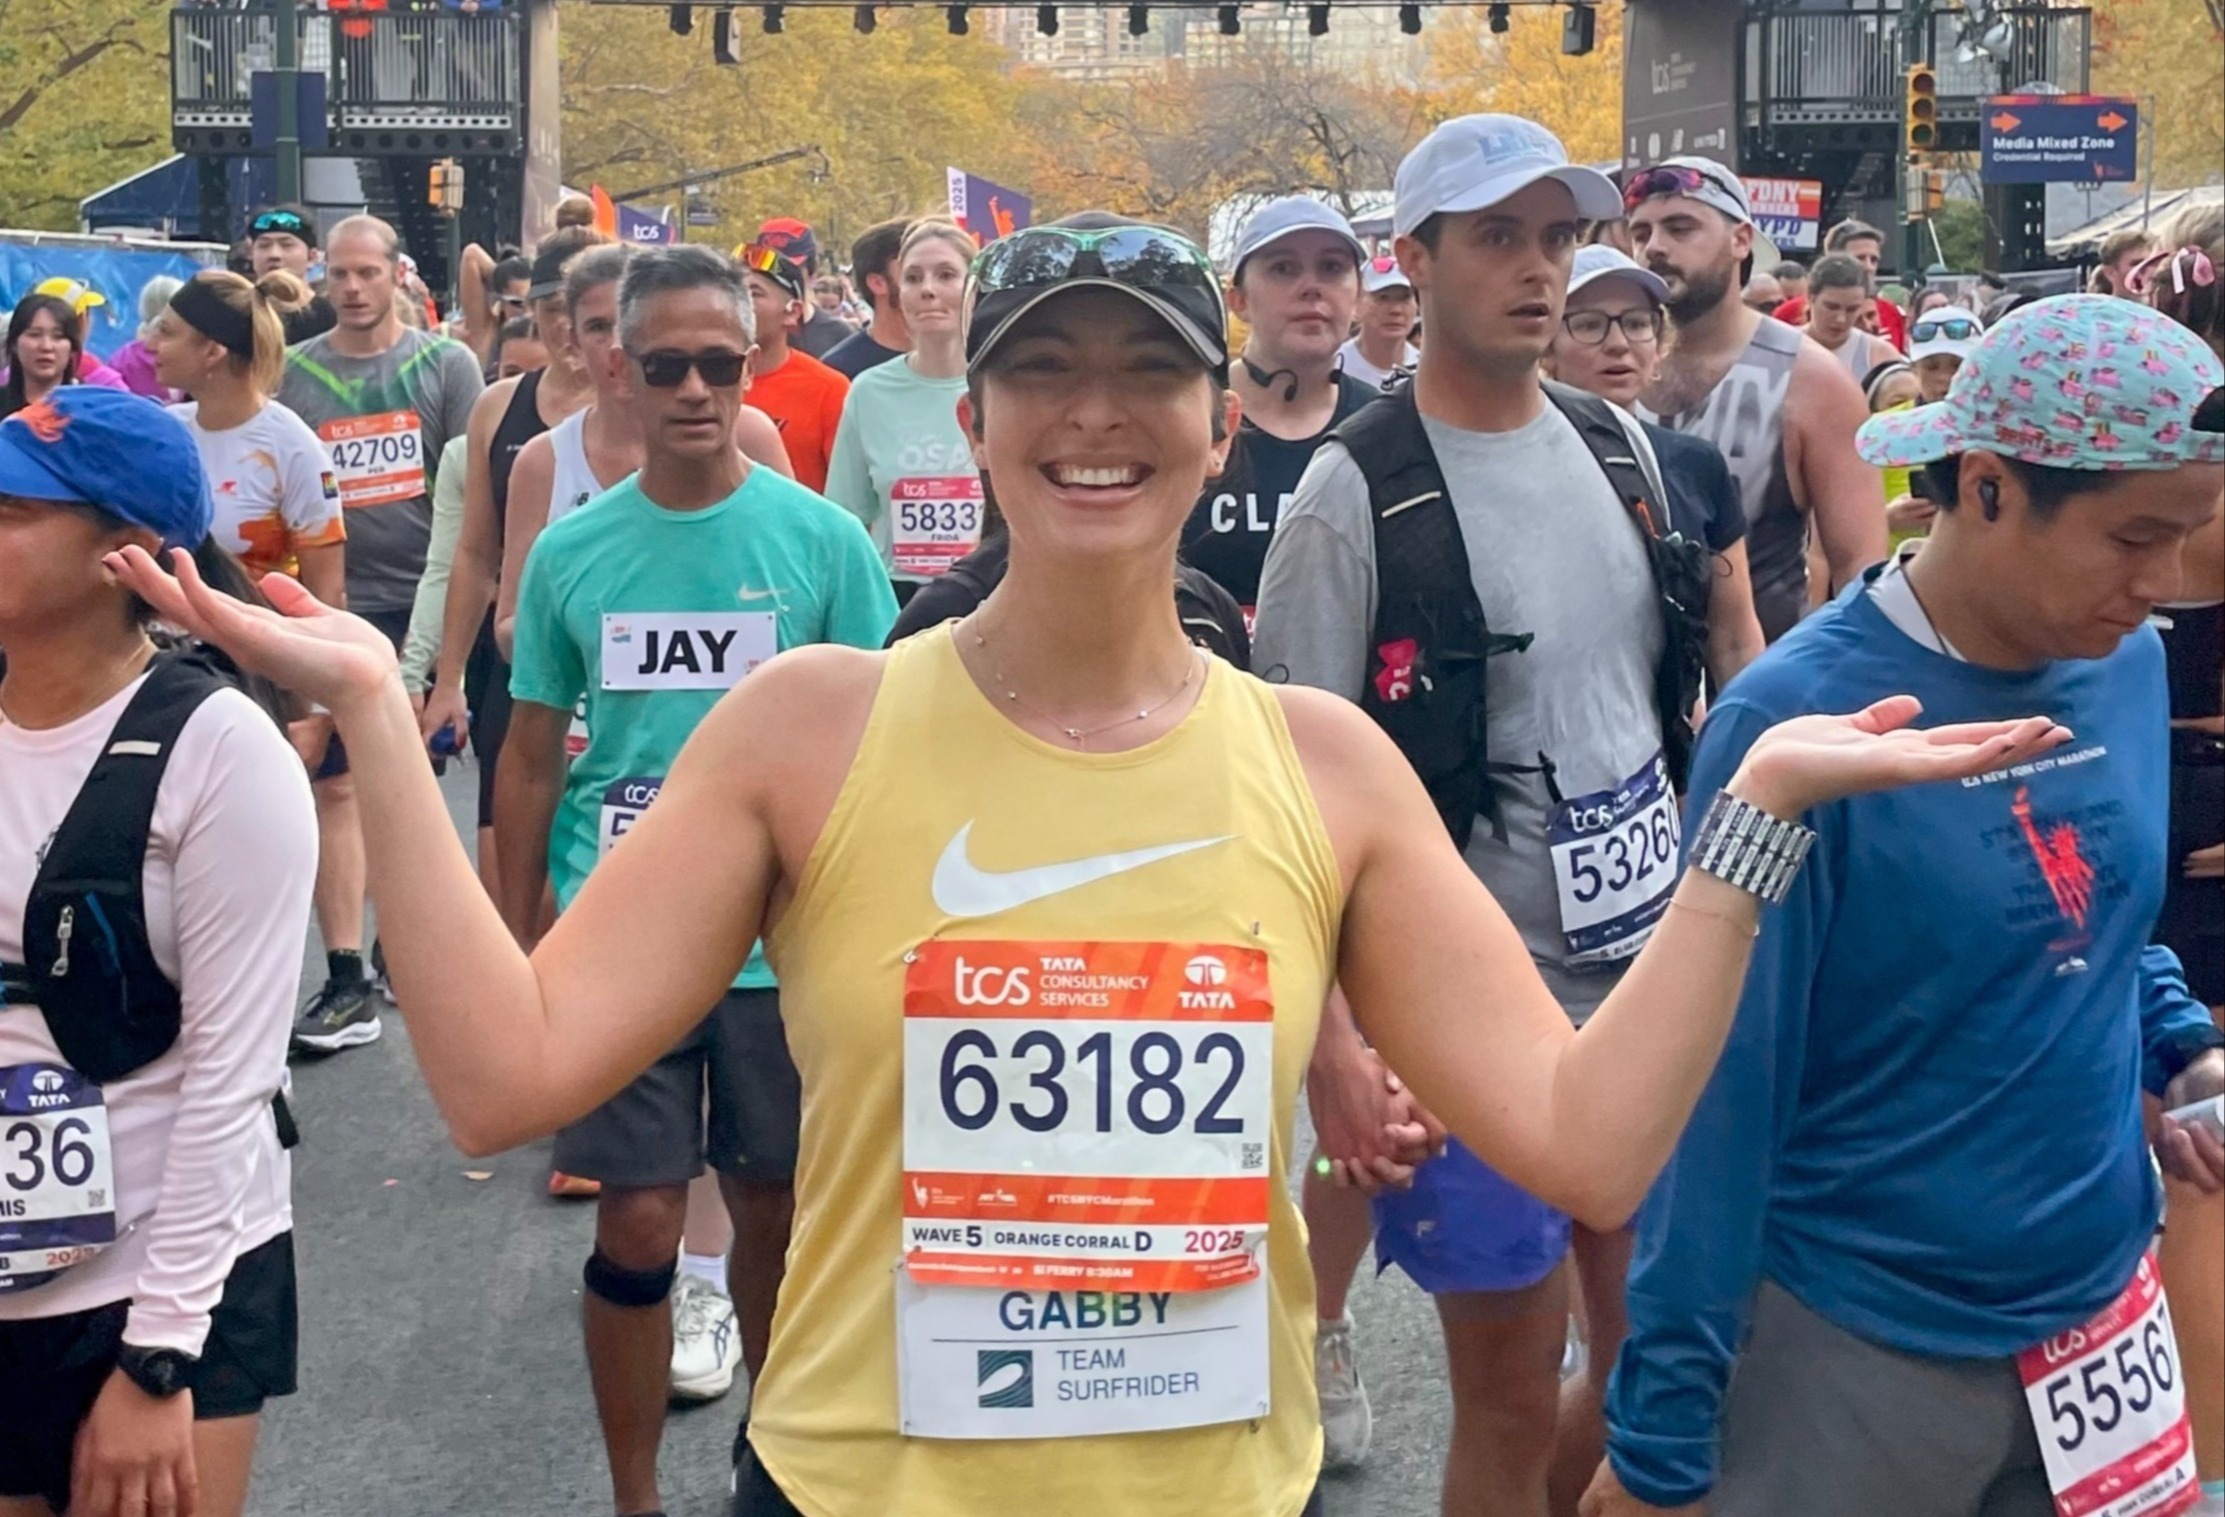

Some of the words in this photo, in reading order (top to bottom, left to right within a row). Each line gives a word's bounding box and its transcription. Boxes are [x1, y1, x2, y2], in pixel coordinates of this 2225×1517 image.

[1993, 137, 2034, 149] Media
[2037, 137, 2077, 149] Mixed
[2081, 136, 2115, 149] Zone
[1993, 152, 2041, 162] Credential
[2044, 152, 2085, 162] Required
[951, 177, 964, 212] 2025
[633, 223, 659, 239] tcs
[333, 433, 416, 469] 42709
[903, 482, 926, 497] tcs
[901, 502, 982, 532] 5833
[638, 630, 738, 674] JAY
[1982, 770, 2008, 784] NEW
[2010, 763, 2035, 777] YORK
[2035, 758, 2055, 772] CITY
[2057, 746, 2107, 766] MARATHON
[1569, 805, 1614, 833] tcs
[1040, 957, 1086, 971] TATA
[955, 956, 1030, 1006] tcs
[1040, 976, 1148, 990] CONSULTANCY
[1040, 993, 1109, 1007] SERVICES
[1179, 992, 1235, 1008] TATA
[940, 1029, 1245, 1135] 63182
[28, 1094, 71, 1108] TATA
[912, 1227, 962, 1243] WAVE
[966, 1226, 982, 1247] 5
[994, 1231, 1060, 1247] ORANGE
[1064, 1234, 1130, 1249] CORRAL
[1135, 1231, 1152, 1252] D
[1185, 1230, 1245, 1254] 2025
[1048, 1265, 1084, 1277] FERRY
[999, 1291, 1172, 1331] GABBY
[1057, 1348, 1125, 1371] TEAM
[1057, 1372, 1200, 1402] SURFRIDER
[2175, 1467, 2185, 1482] A
